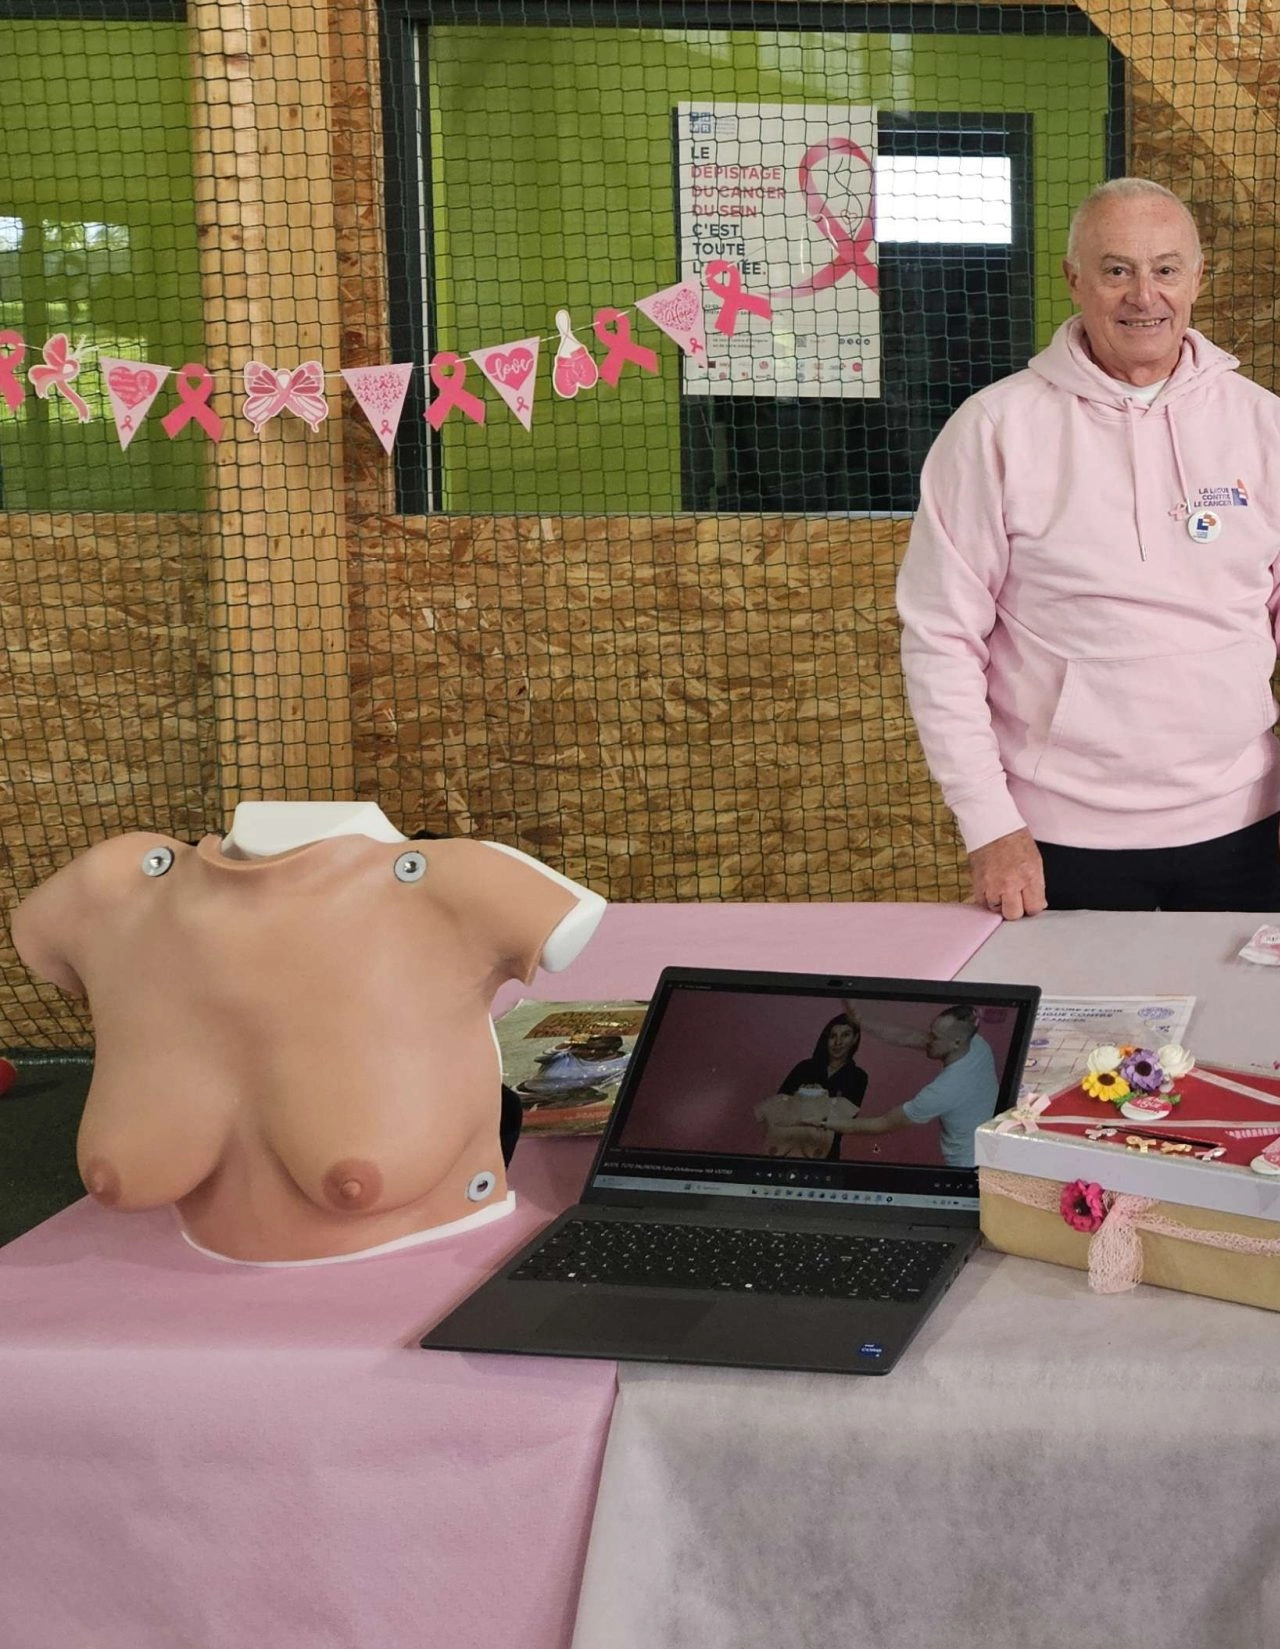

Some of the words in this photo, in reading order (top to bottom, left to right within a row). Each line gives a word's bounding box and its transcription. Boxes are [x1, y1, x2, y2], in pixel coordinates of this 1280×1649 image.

[691, 147, 710, 159] LE
[691, 185, 714, 198] DU
[719, 186, 785, 199] CANCER
[692, 204, 714, 217] DU
[720, 205, 757, 218] SEIN
[692, 224, 740, 236] C'EST
[692, 242, 745, 256] TOUTE
[491, 357, 533, 382] love
